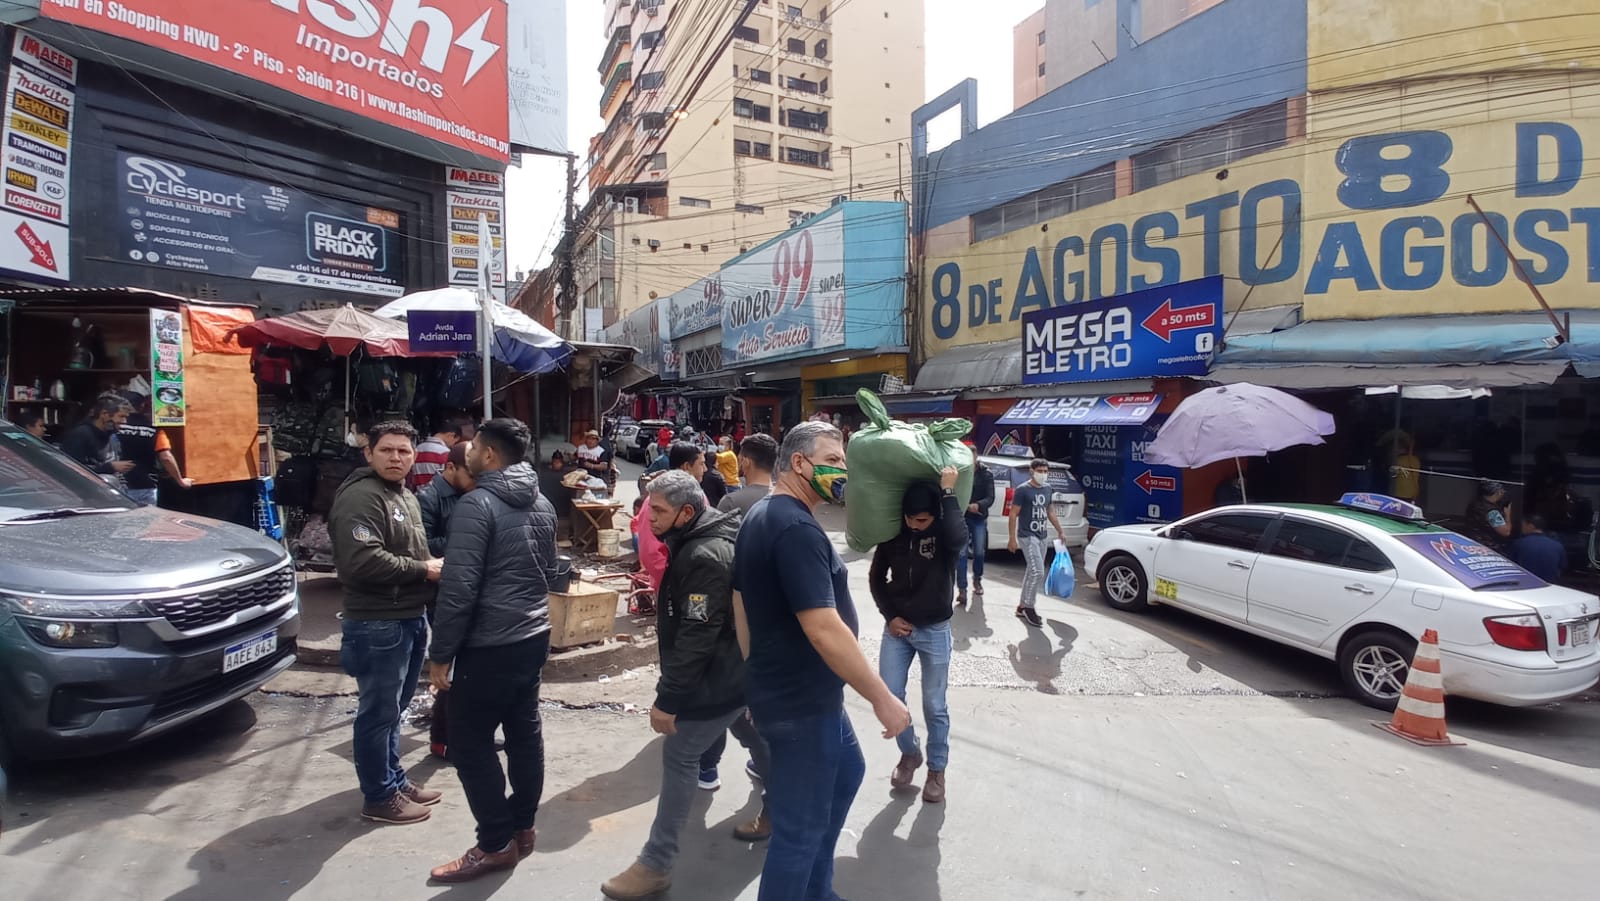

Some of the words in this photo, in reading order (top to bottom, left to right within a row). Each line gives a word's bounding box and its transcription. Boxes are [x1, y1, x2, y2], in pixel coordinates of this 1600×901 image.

[295, 24, 445, 99] Importados
[107, 1, 180, 41] Shopping
[183, 24, 220, 52] HWU
[253, 49, 285, 75] Piso
[296, 65, 333, 92] Salón
[335, 79, 359, 101] 216
[367, 92, 510, 154] www.flashimportados.com.py
[18, 119, 61, 142] STANLEY
[12, 136, 64, 162] TRAMONTINA
[7, 169, 35, 186] IRWIN
[1335, 130, 1453, 210] 8
[127, 170, 246, 210] Cyclesport
[8, 193, 60, 217] LORENZETTI
[144, 196, 174, 209] TIENDA
[175, 201, 232, 218] MULTIDEPORTE
[145, 211, 191, 224] BICICLETAS
[149, 224, 191, 236] SOPORTES
[314, 221, 375, 247] BLACK
[21, 228, 54, 267] SUB-SOLO
[314, 236, 378, 260] FRIDAY
[932, 261, 961, 339] 8
[968, 278, 1003, 328] DE
[1008, 178, 1302, 322] AGOSTO
[296, 264, 310, 274] del
[311, 265, 320, 273] 14
[331, 269, 339, 277] 17
[352, 272, 393, 285] noviembre
[773, 229, 814, 315] 99
[730, 289, 772, 329] SUPER
[1161, 317, 1168, 326] a
[1169, 313, 1183, 325] 50
[1184, 311, 1207, 323] mts
[419, 333, 450, 342] Adrian
[452, 333, 473, 342] Jara
[435, 323, 455, 332] Avda
[1026, 306, 1132, 354] MEGA
[1026, 343, 1132, 375] ELETRO
[1005, 406, 1091, 420] ELETRO
[1084, 434, 1117, 449] TAXI
[1032, 494, 1046, 506] JO
[226, 647, 252, 670] AAEE
